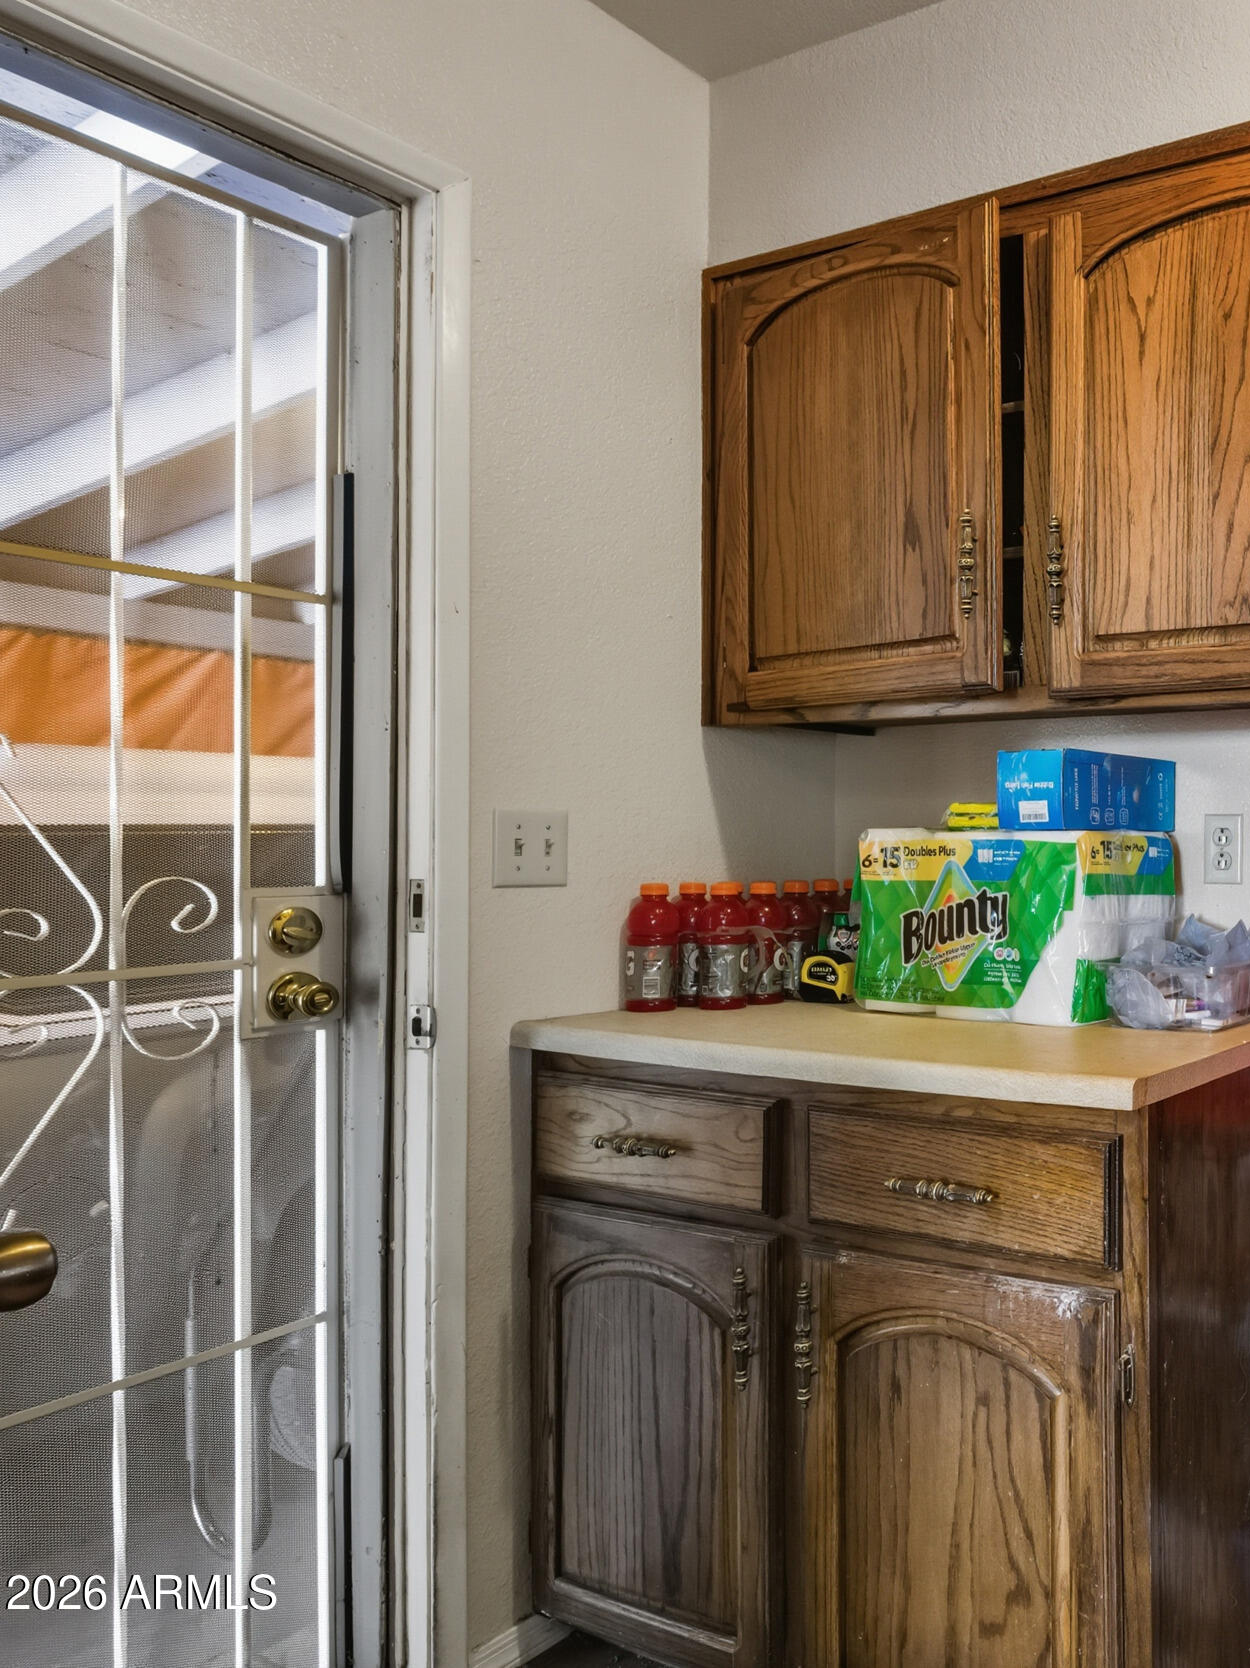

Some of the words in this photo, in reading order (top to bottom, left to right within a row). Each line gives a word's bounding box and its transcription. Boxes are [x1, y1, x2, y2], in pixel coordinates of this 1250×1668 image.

[880, 846, 902, 869] 15
[903, 846, 937, 857] Doubles
[938, 845, 957, 857] Plus
[901, 887, 1009, 966] Bounty
